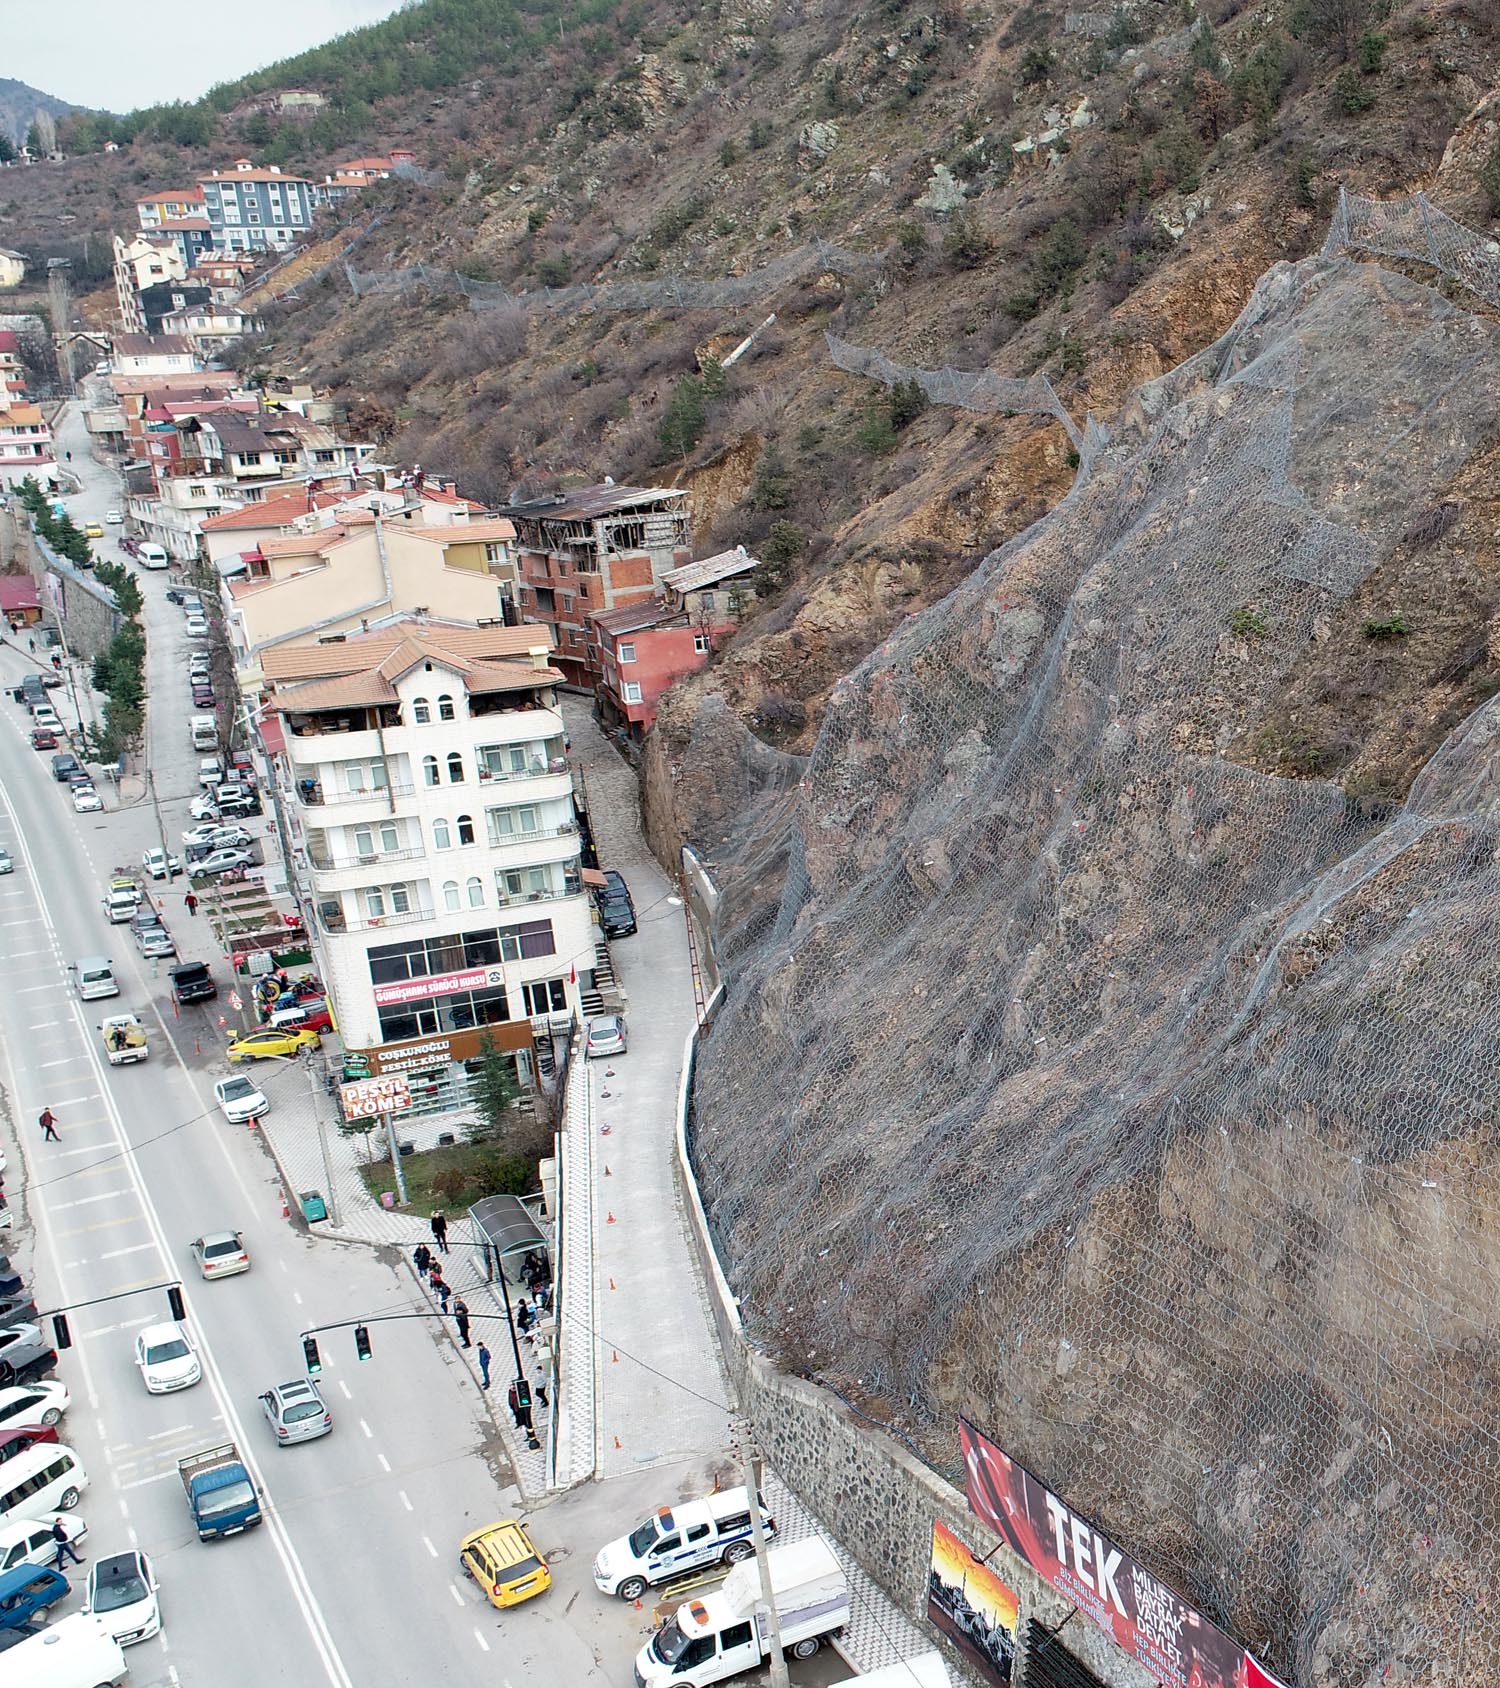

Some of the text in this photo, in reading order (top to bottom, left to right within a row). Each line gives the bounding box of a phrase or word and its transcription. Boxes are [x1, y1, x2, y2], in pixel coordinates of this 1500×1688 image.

[376, 985, 429, 1002] GÜMÜŞHANE
[428, 977, 460, 993] SÜRÜCÜ
[460, 974, 486, 988] KURSU
[378, 1040, 450, 1061] COŞKUNOĞLU
[347, 1080, 406, 1100] PESTİL
[352, 1095, 406, 1117] KÖME
[1045, 1490, 1129, 1620] TEK
[1132, 1565, 1175, 1611] MİLLET
[1133, 1582, 1184, 1636] BAYRAK
[1135, 1598, 1177, 1646] VATAN
[1136, 1614, 1183, 1666] DEVLET
[1132, 1630, 1188, 1686] HEP BİRLİKTE
